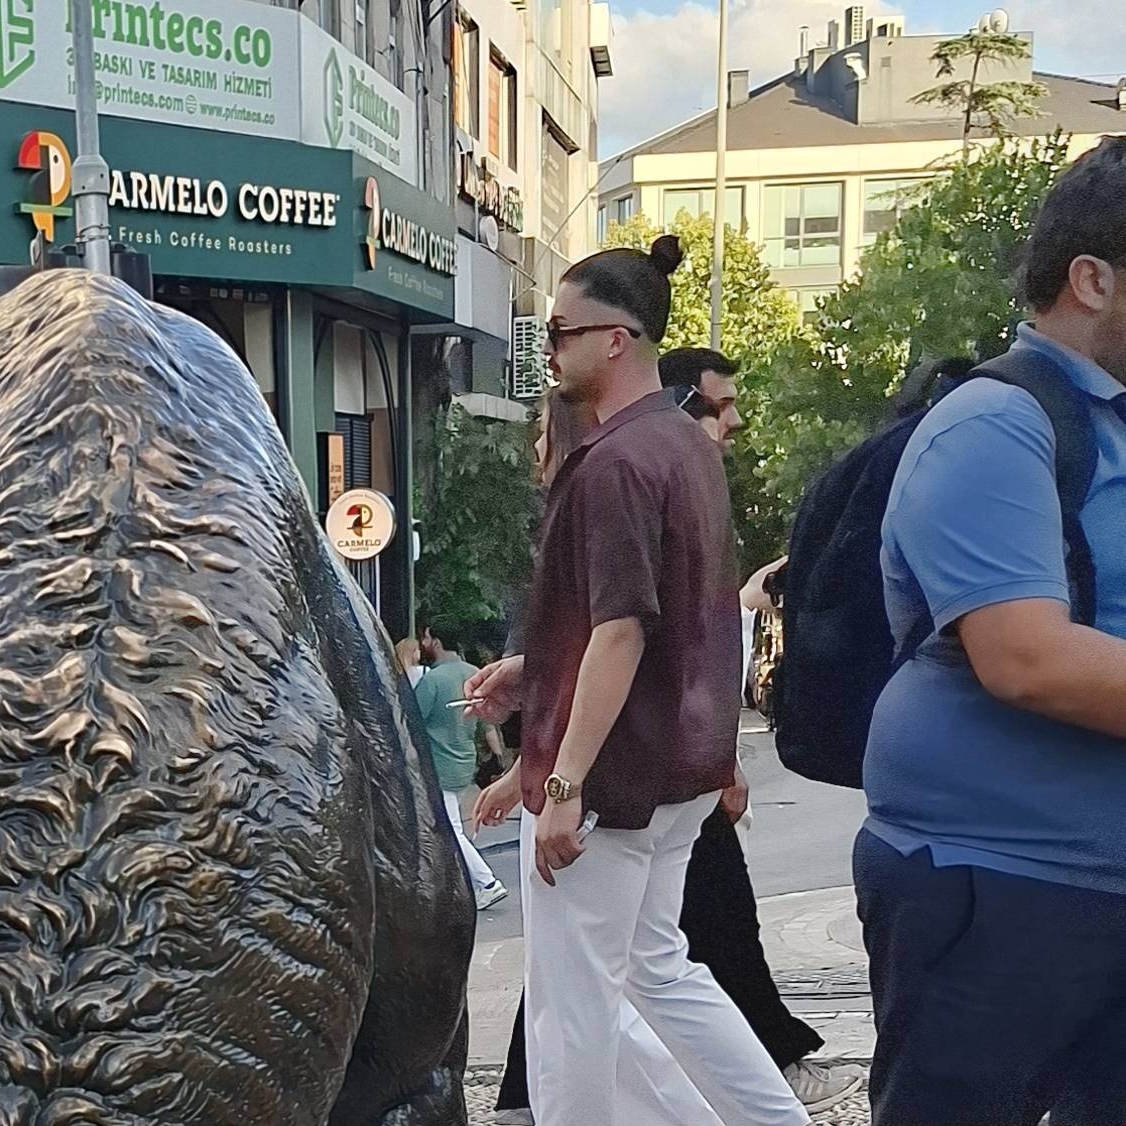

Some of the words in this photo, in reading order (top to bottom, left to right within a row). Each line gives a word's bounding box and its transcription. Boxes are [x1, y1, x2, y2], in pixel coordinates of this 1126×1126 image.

[66, 0, 272, 67] rintecs.co
[94, 52, 133, 76] BASKI
[139, 59, 156, 80] VE
[162, 63, 217, 90] TASARIM
[108, 169, 229, 218] ARMELO
[119, 226, 162, 245] Fresh
[170, 231, 222, 250] Coffee
[228, 236, 292, 255] Roasters
[382, 207, 428, 264] CARMELO
